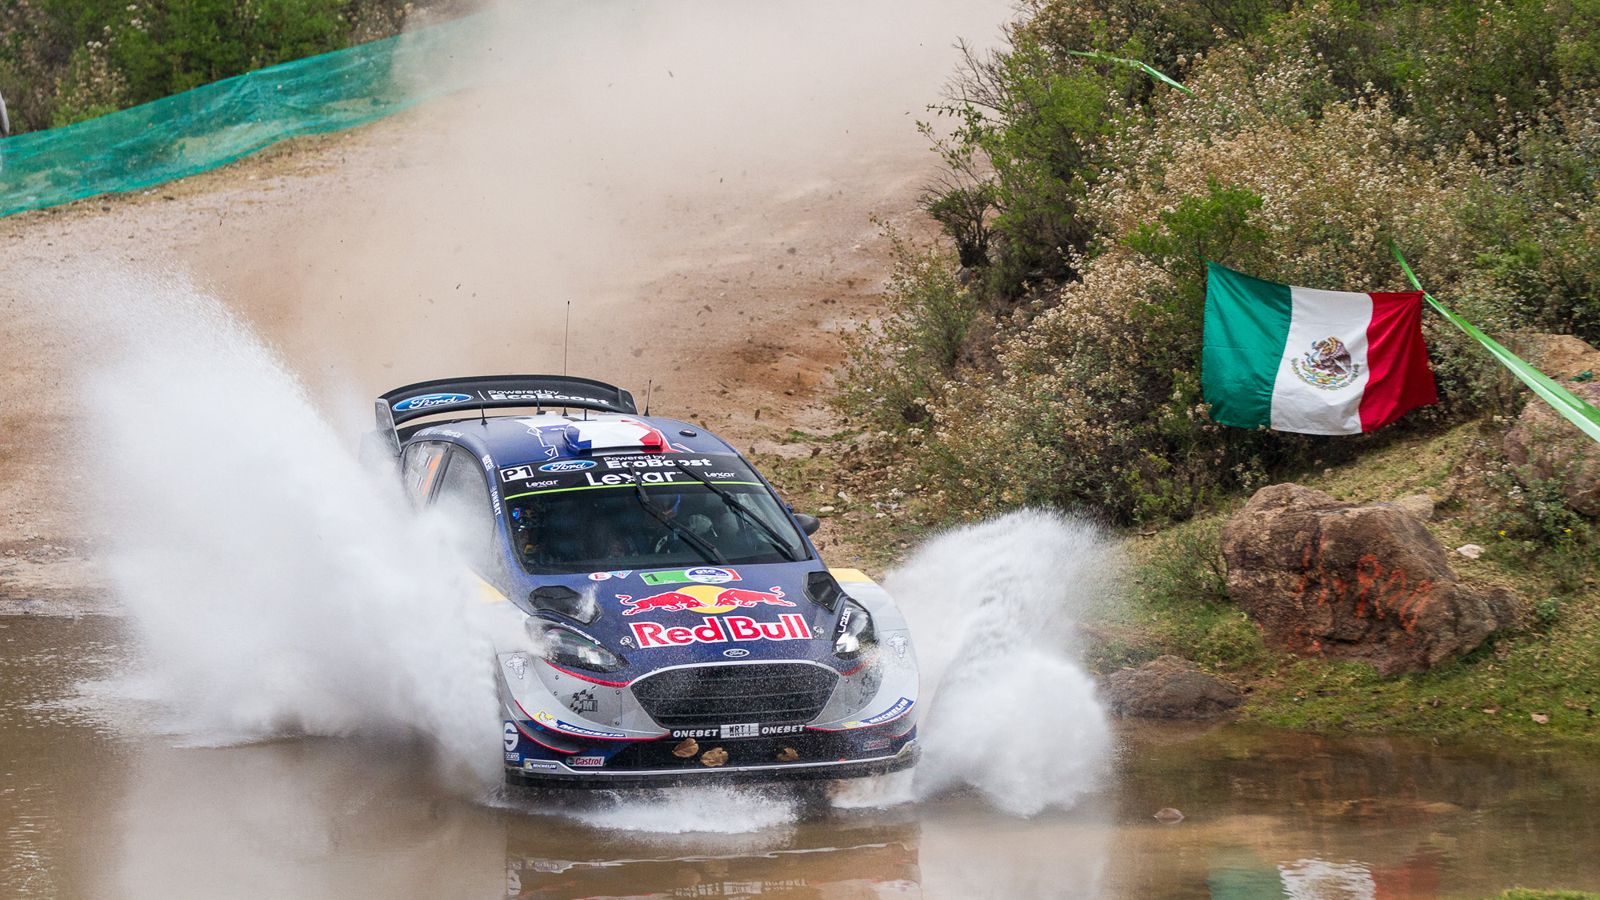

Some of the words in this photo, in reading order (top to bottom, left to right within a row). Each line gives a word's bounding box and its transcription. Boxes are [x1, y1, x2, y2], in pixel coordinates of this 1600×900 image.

[490, 393, 609, 406] EcoBoost
[502, 466, 532, 481] P1
[585, 471, 677, 486] Lexar
[704, 471, 736, 479] Lexar
[525, 480, 559, 488] Lexar
[630, 616, 727, 648] Red
[724, 614, 811, 641] Bull
[869, 698, 908, 724] MICHELIN
[558, 724, 625, 738] MICHELIN
[672, 728, 719, 738] ONEBET
[761, 724, 806, 735] ONEBET
[575, 757, 602, 766] Castrol
